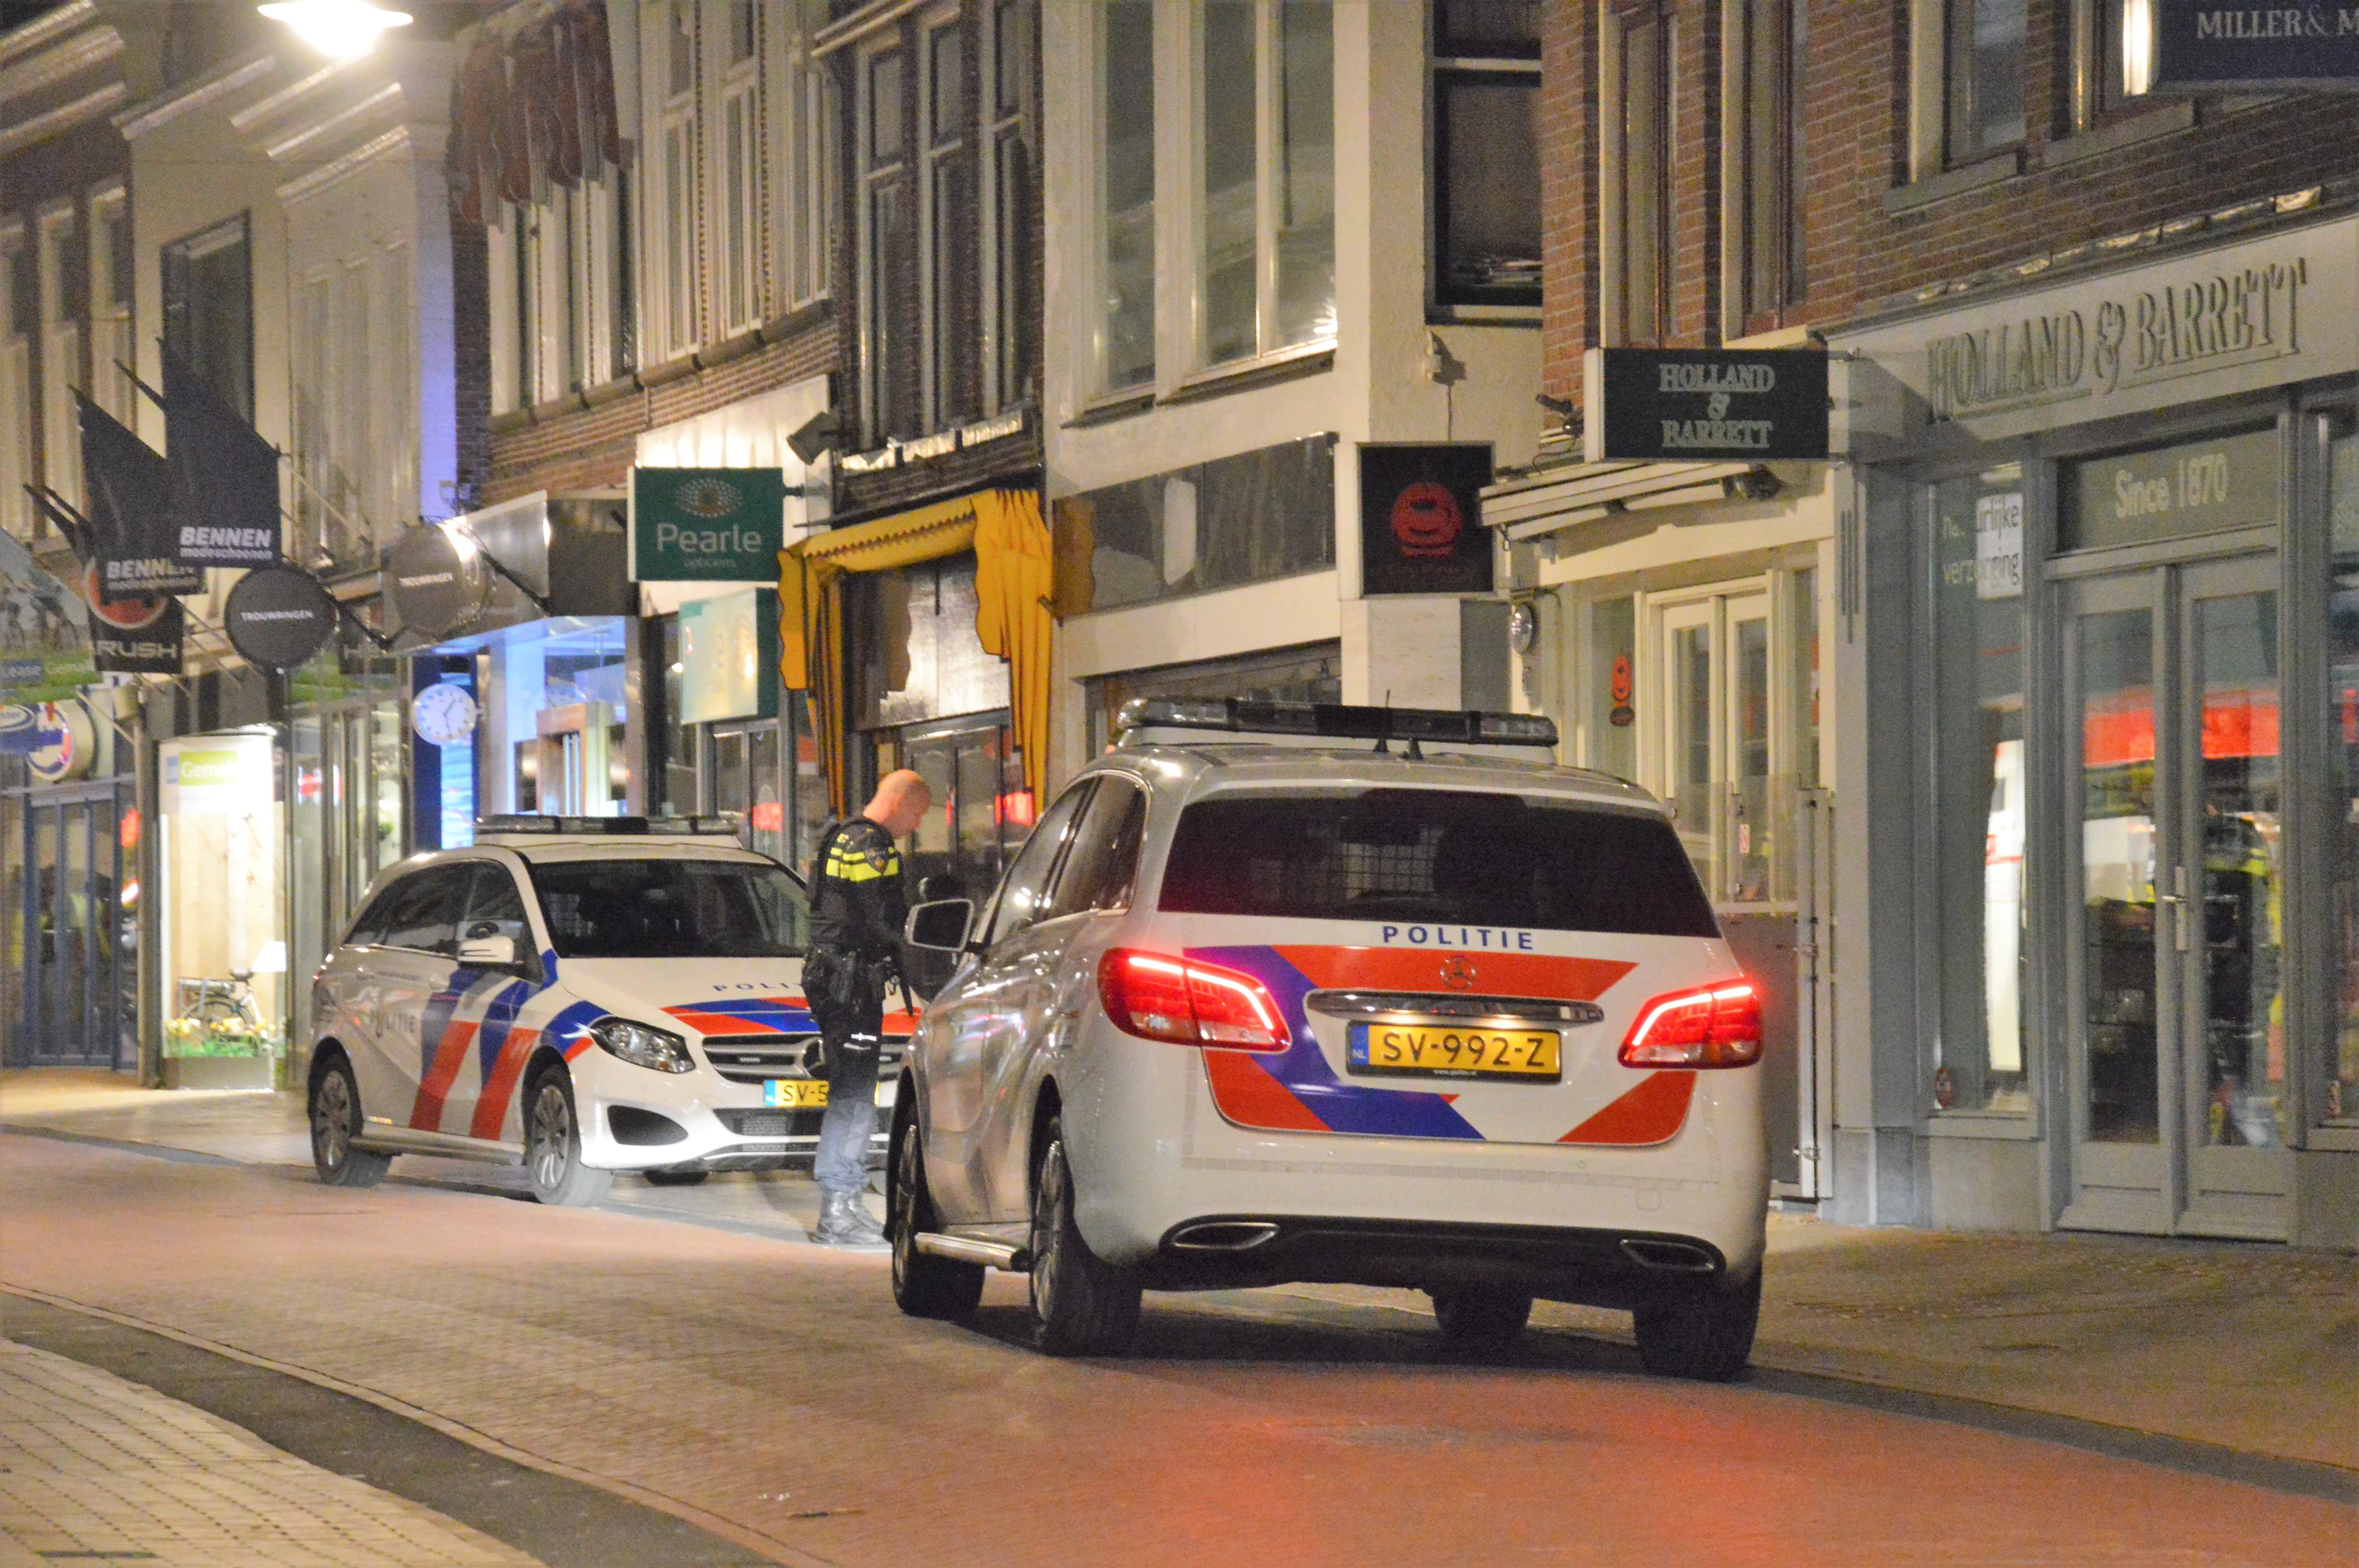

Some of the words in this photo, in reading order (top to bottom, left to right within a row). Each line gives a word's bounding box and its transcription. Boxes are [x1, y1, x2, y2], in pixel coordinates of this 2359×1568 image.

[2135, 257, 2306, 373] BARRETT
[1659, 364, 1775, 392] HOLLAND
[1707, 392, 1731, 419] &
[1661, 419, 1774, 448] BARRETT
[2115, 469, 2170, 518] Since
[2180, 453, 2228, 507] 1870
[180, 526, 272, 548] BENNEN
[657, 523, 762, 553] Pearle
[241, 609, 313, 622] TROUWRINGEN
[1382, 925, 1533, 951] POLITIE
[1352, 1048, 1367, 1059] NL
[1382, 1031, 1544, 1067] SV-992-Z
[783, 1084, 829, 1102] SV-5
